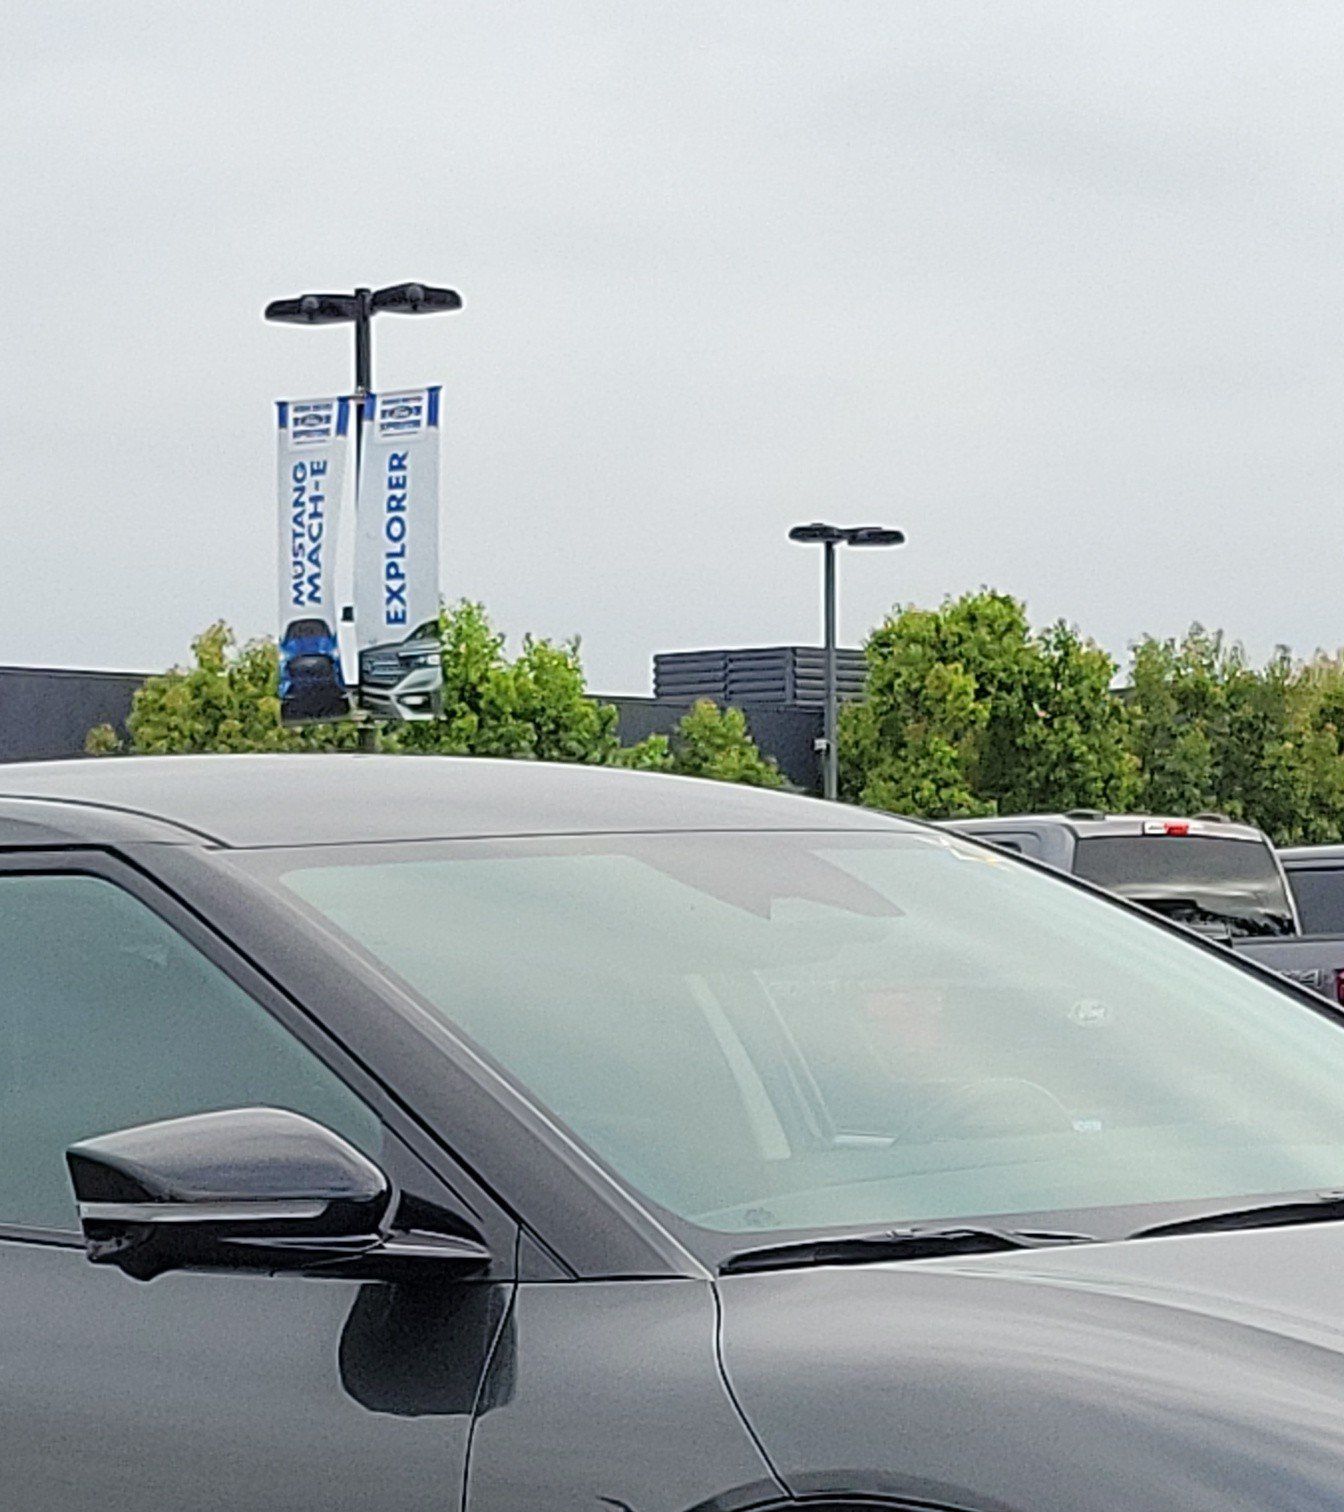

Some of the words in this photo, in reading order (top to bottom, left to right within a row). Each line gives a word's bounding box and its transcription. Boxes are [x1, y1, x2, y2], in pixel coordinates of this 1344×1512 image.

[292, 461, 306, 606] MUSTANG
[307, 460, 327, 604] MACH-E
[385, 451, 408, 625] EXPLORER
